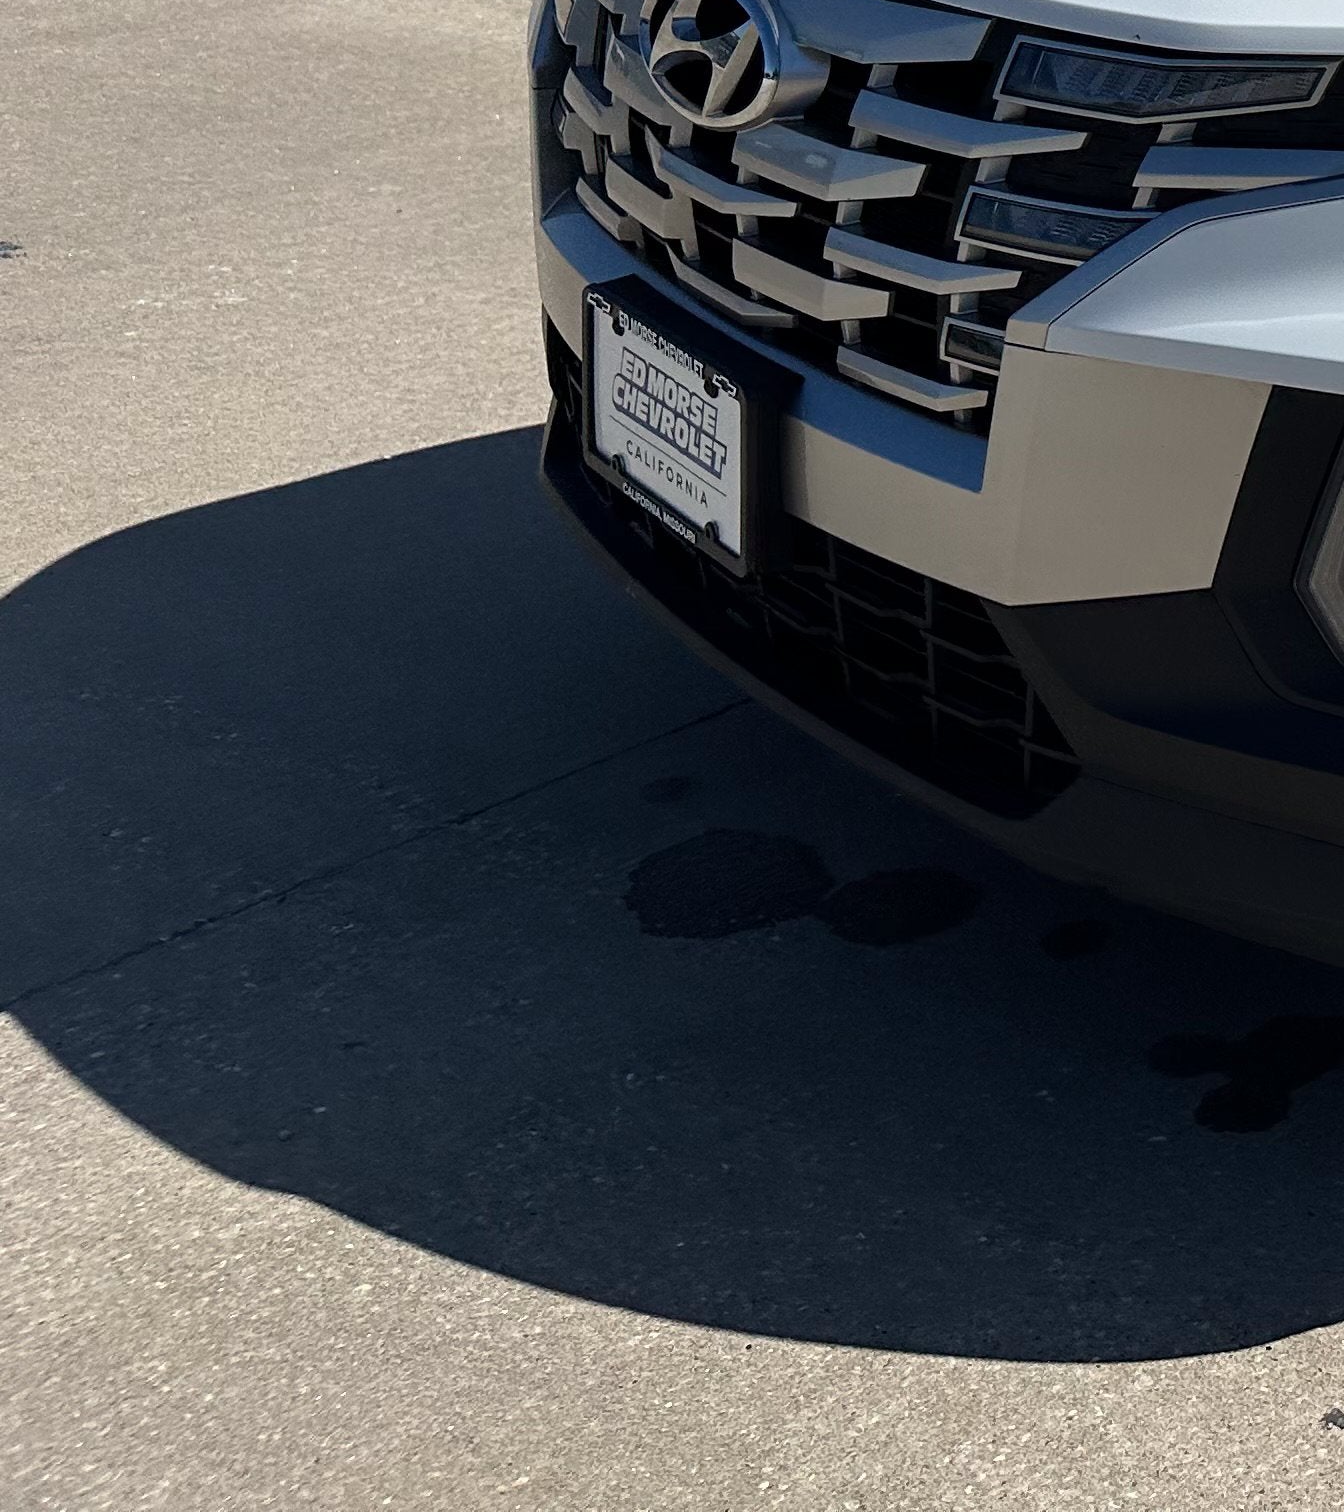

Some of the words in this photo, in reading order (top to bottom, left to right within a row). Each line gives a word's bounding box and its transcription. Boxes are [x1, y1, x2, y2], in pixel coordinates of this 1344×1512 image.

[619, 309, 629, 331] ED
[611, 373, 728, 479] CHEVROLET
[620, 346, 648, 389] ED
[647, 360, 719, 437] MORSE
[626, 440, 709, 509] CALIFORNIA
